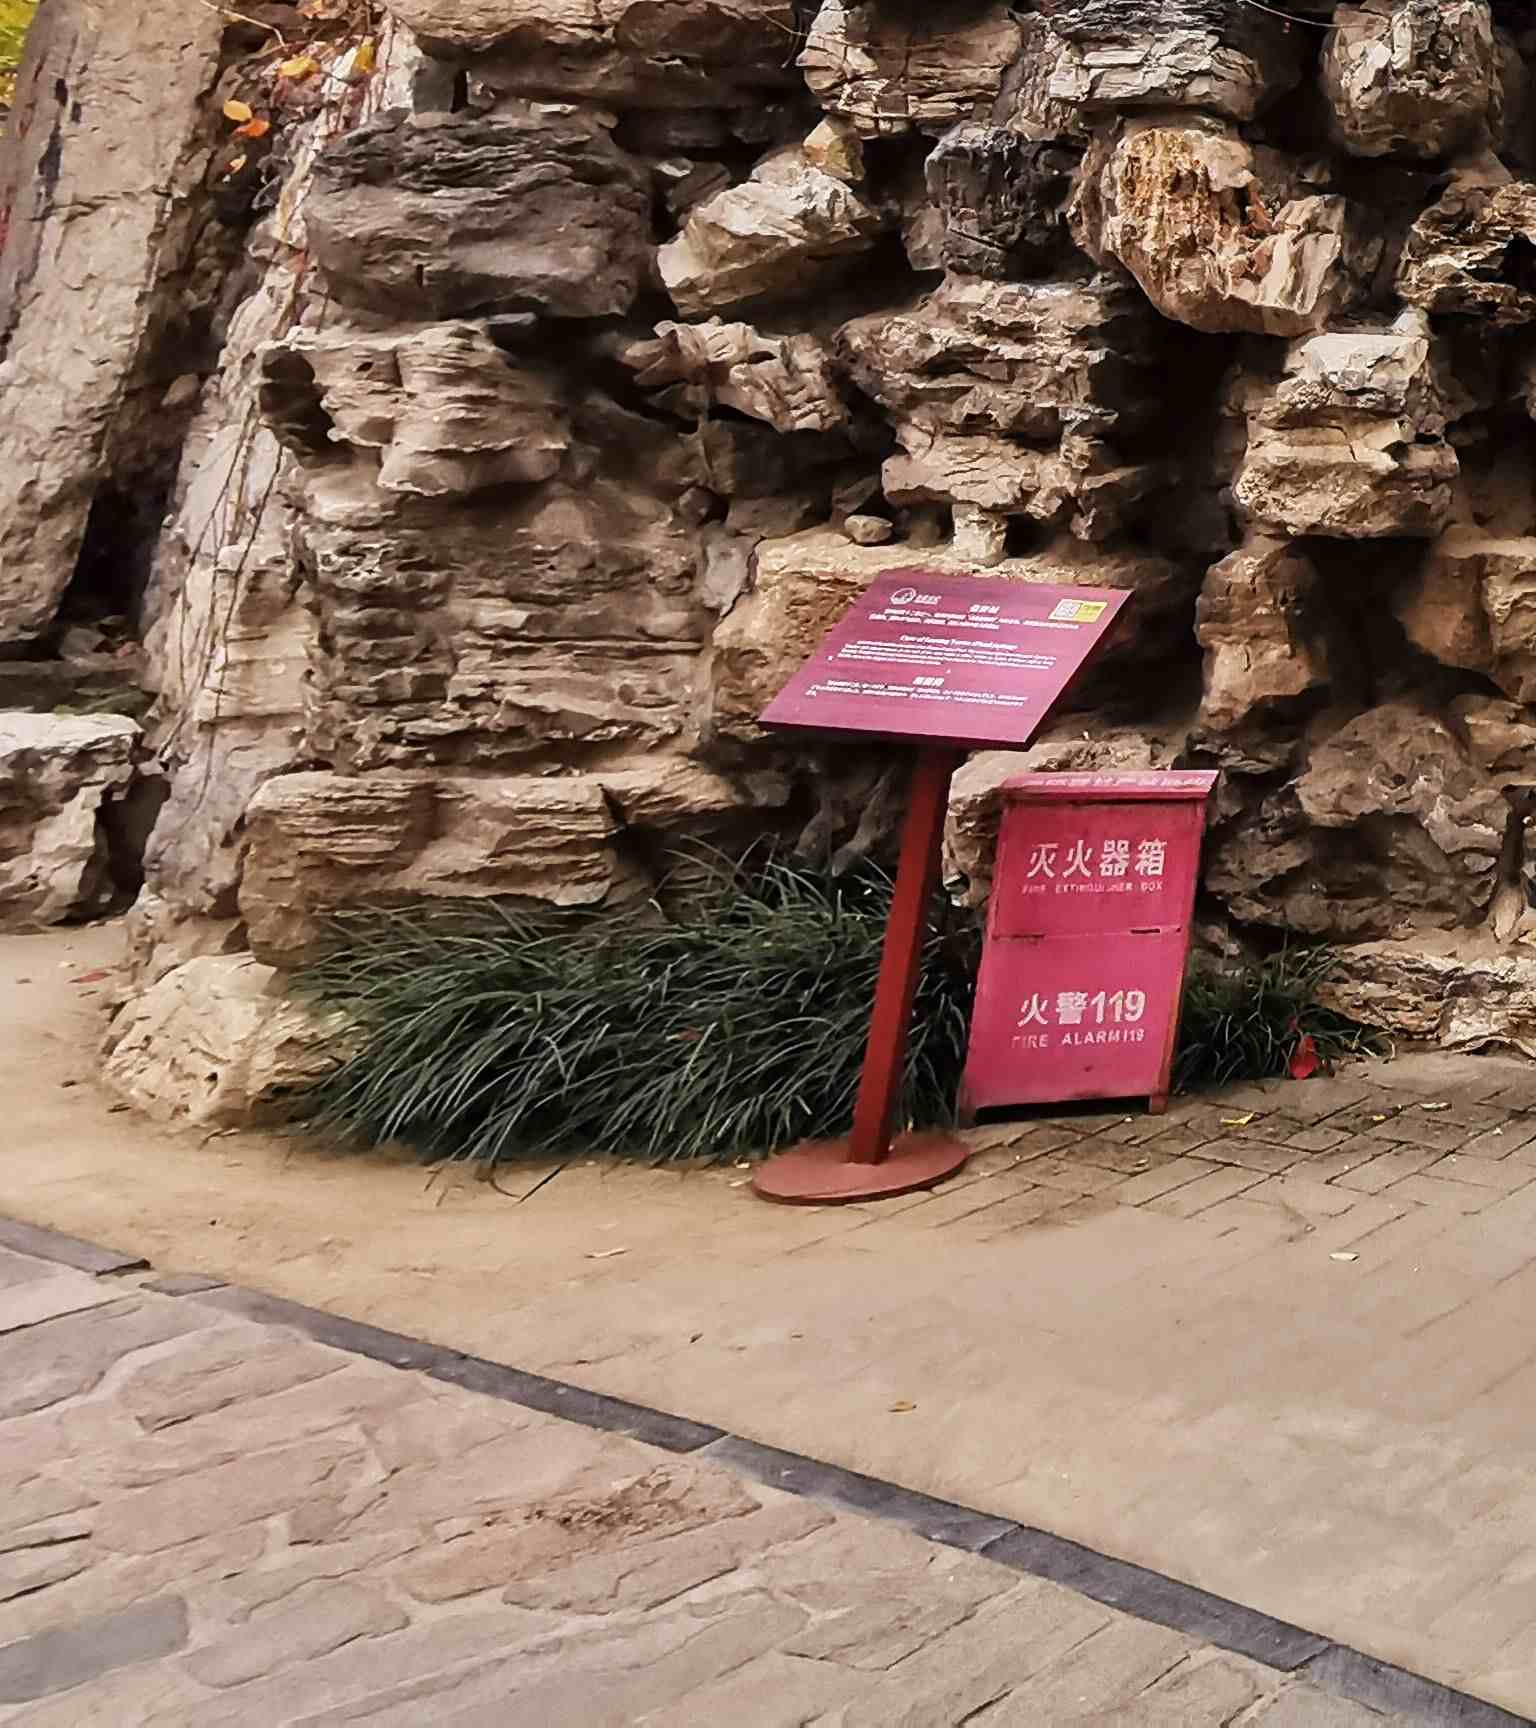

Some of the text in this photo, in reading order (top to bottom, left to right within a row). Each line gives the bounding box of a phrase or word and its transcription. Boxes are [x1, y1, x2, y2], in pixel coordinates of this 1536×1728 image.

[1026, 837, 1168, 879] 灭火器箱
[1016, 988, 1147, 1028] 火警119
[1011, 1033, 1049, 1049] FIRE
